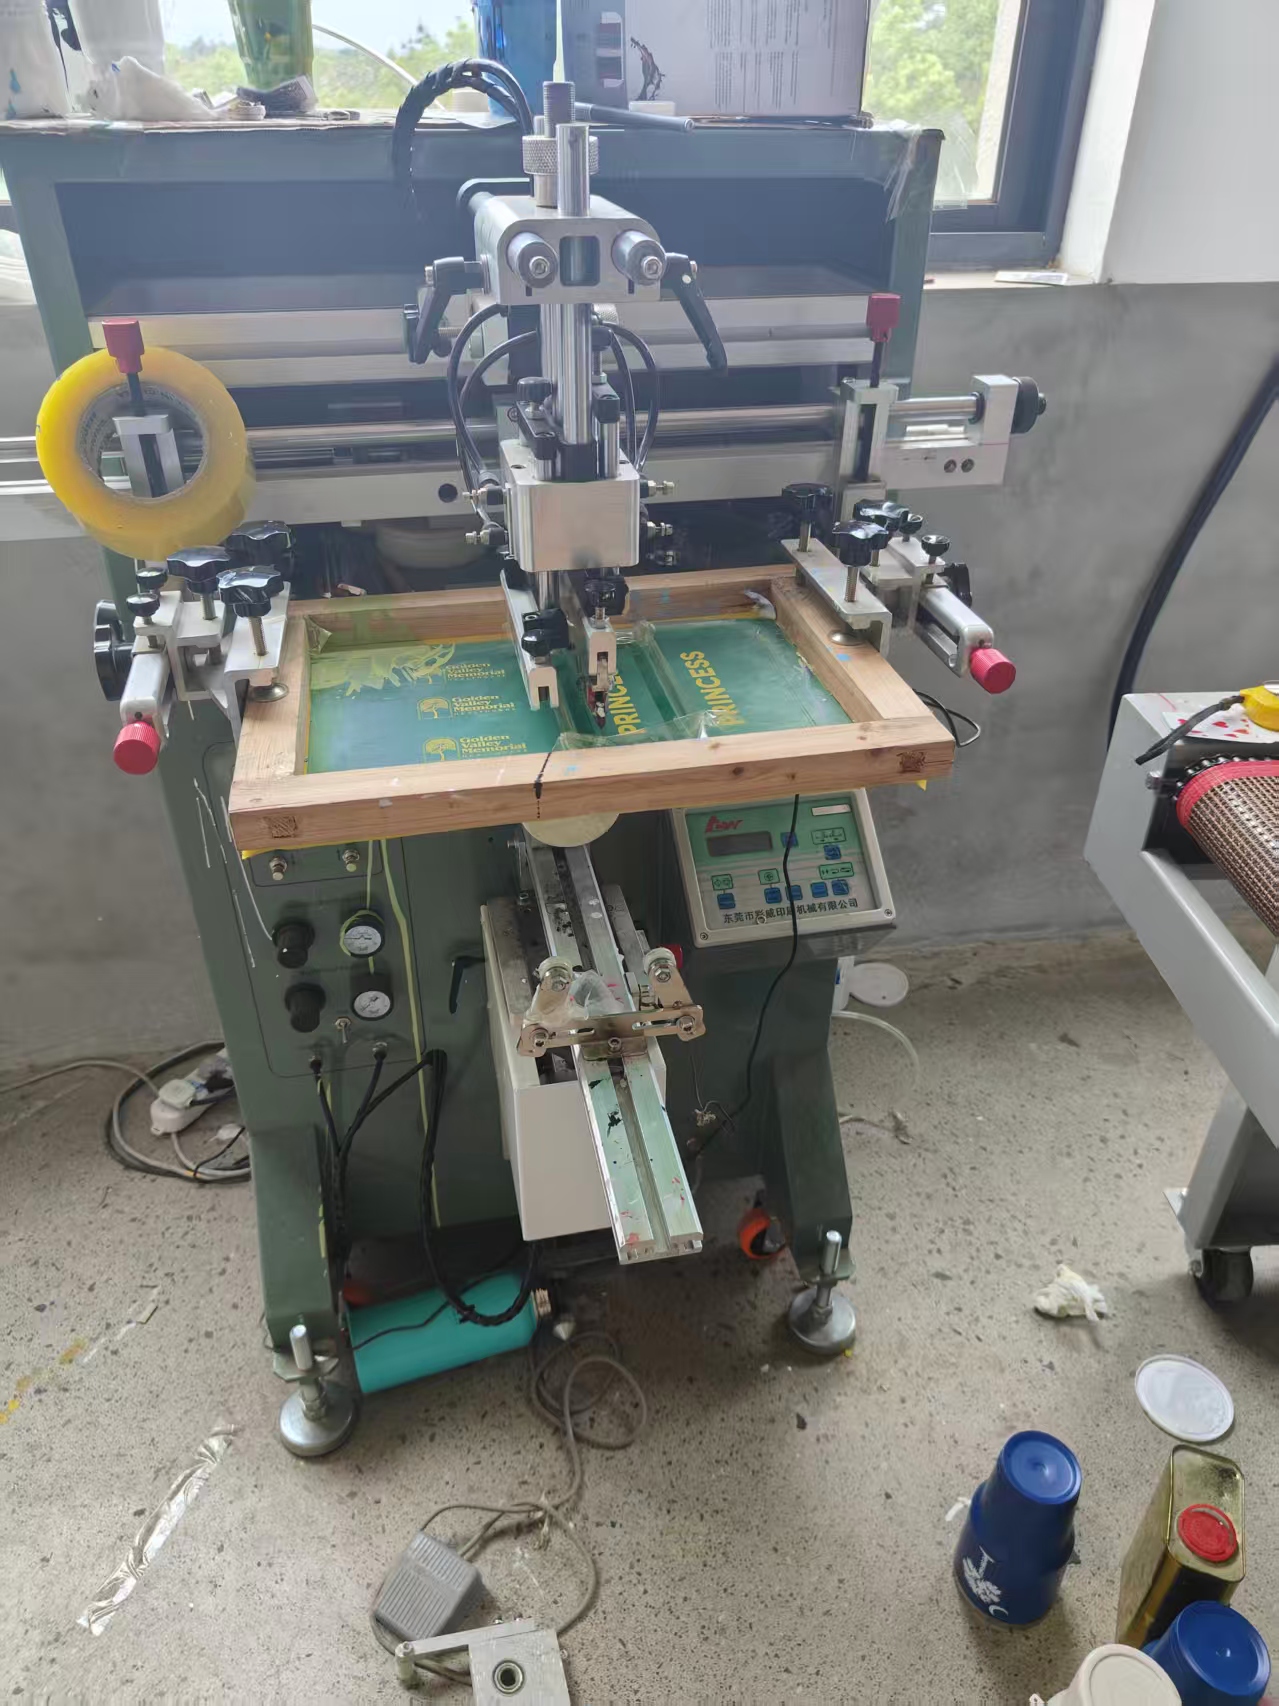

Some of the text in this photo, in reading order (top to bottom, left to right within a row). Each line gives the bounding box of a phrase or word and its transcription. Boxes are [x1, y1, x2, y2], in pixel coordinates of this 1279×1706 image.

[448, 669, 505, 678] Memorial
[680, 651, 745, 725] PRINCESS
[453, 702, 515, 712] Memorial
[462, 742, 526, 754] Memorial
